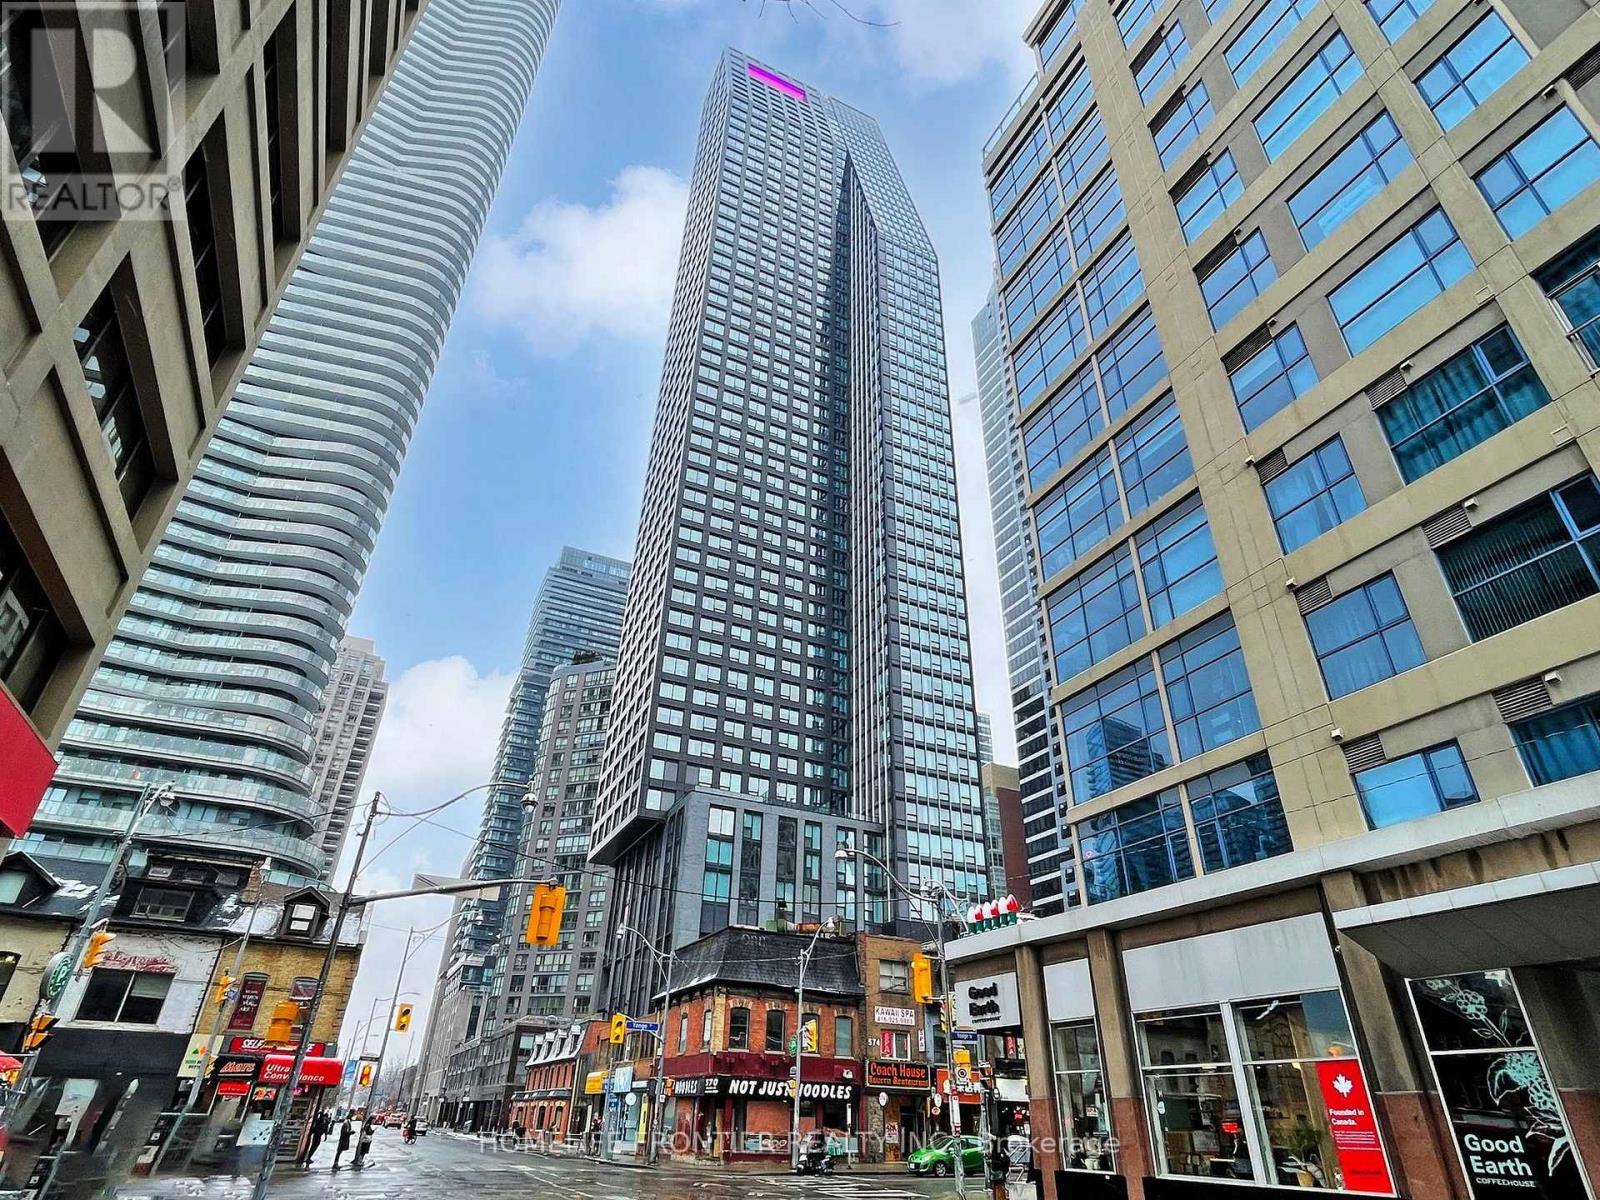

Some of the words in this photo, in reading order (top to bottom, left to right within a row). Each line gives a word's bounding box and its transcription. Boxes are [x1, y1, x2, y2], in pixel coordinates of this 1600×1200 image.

[968, 982, 999, 1000] Good
[901, 1009, 913, 1018] SPA
[969, 999, 1000, 1017] Earth
[868, 1038, 880, 1047] 574
[266, 1063, 291, 1072] Ultra
[870, 1062, 897, 1076] Coach
[900, 1064, 926, 1078] House
[705, 1078, 718, 1087] 570
[728, 1079, 757, 1095] NOT
[1464, 1133, 1525, 1154] Good
[1469, 1155, 1533, 1176] Earth
[1475, 1177, 1537, 1188] COFFEEHOUSE
